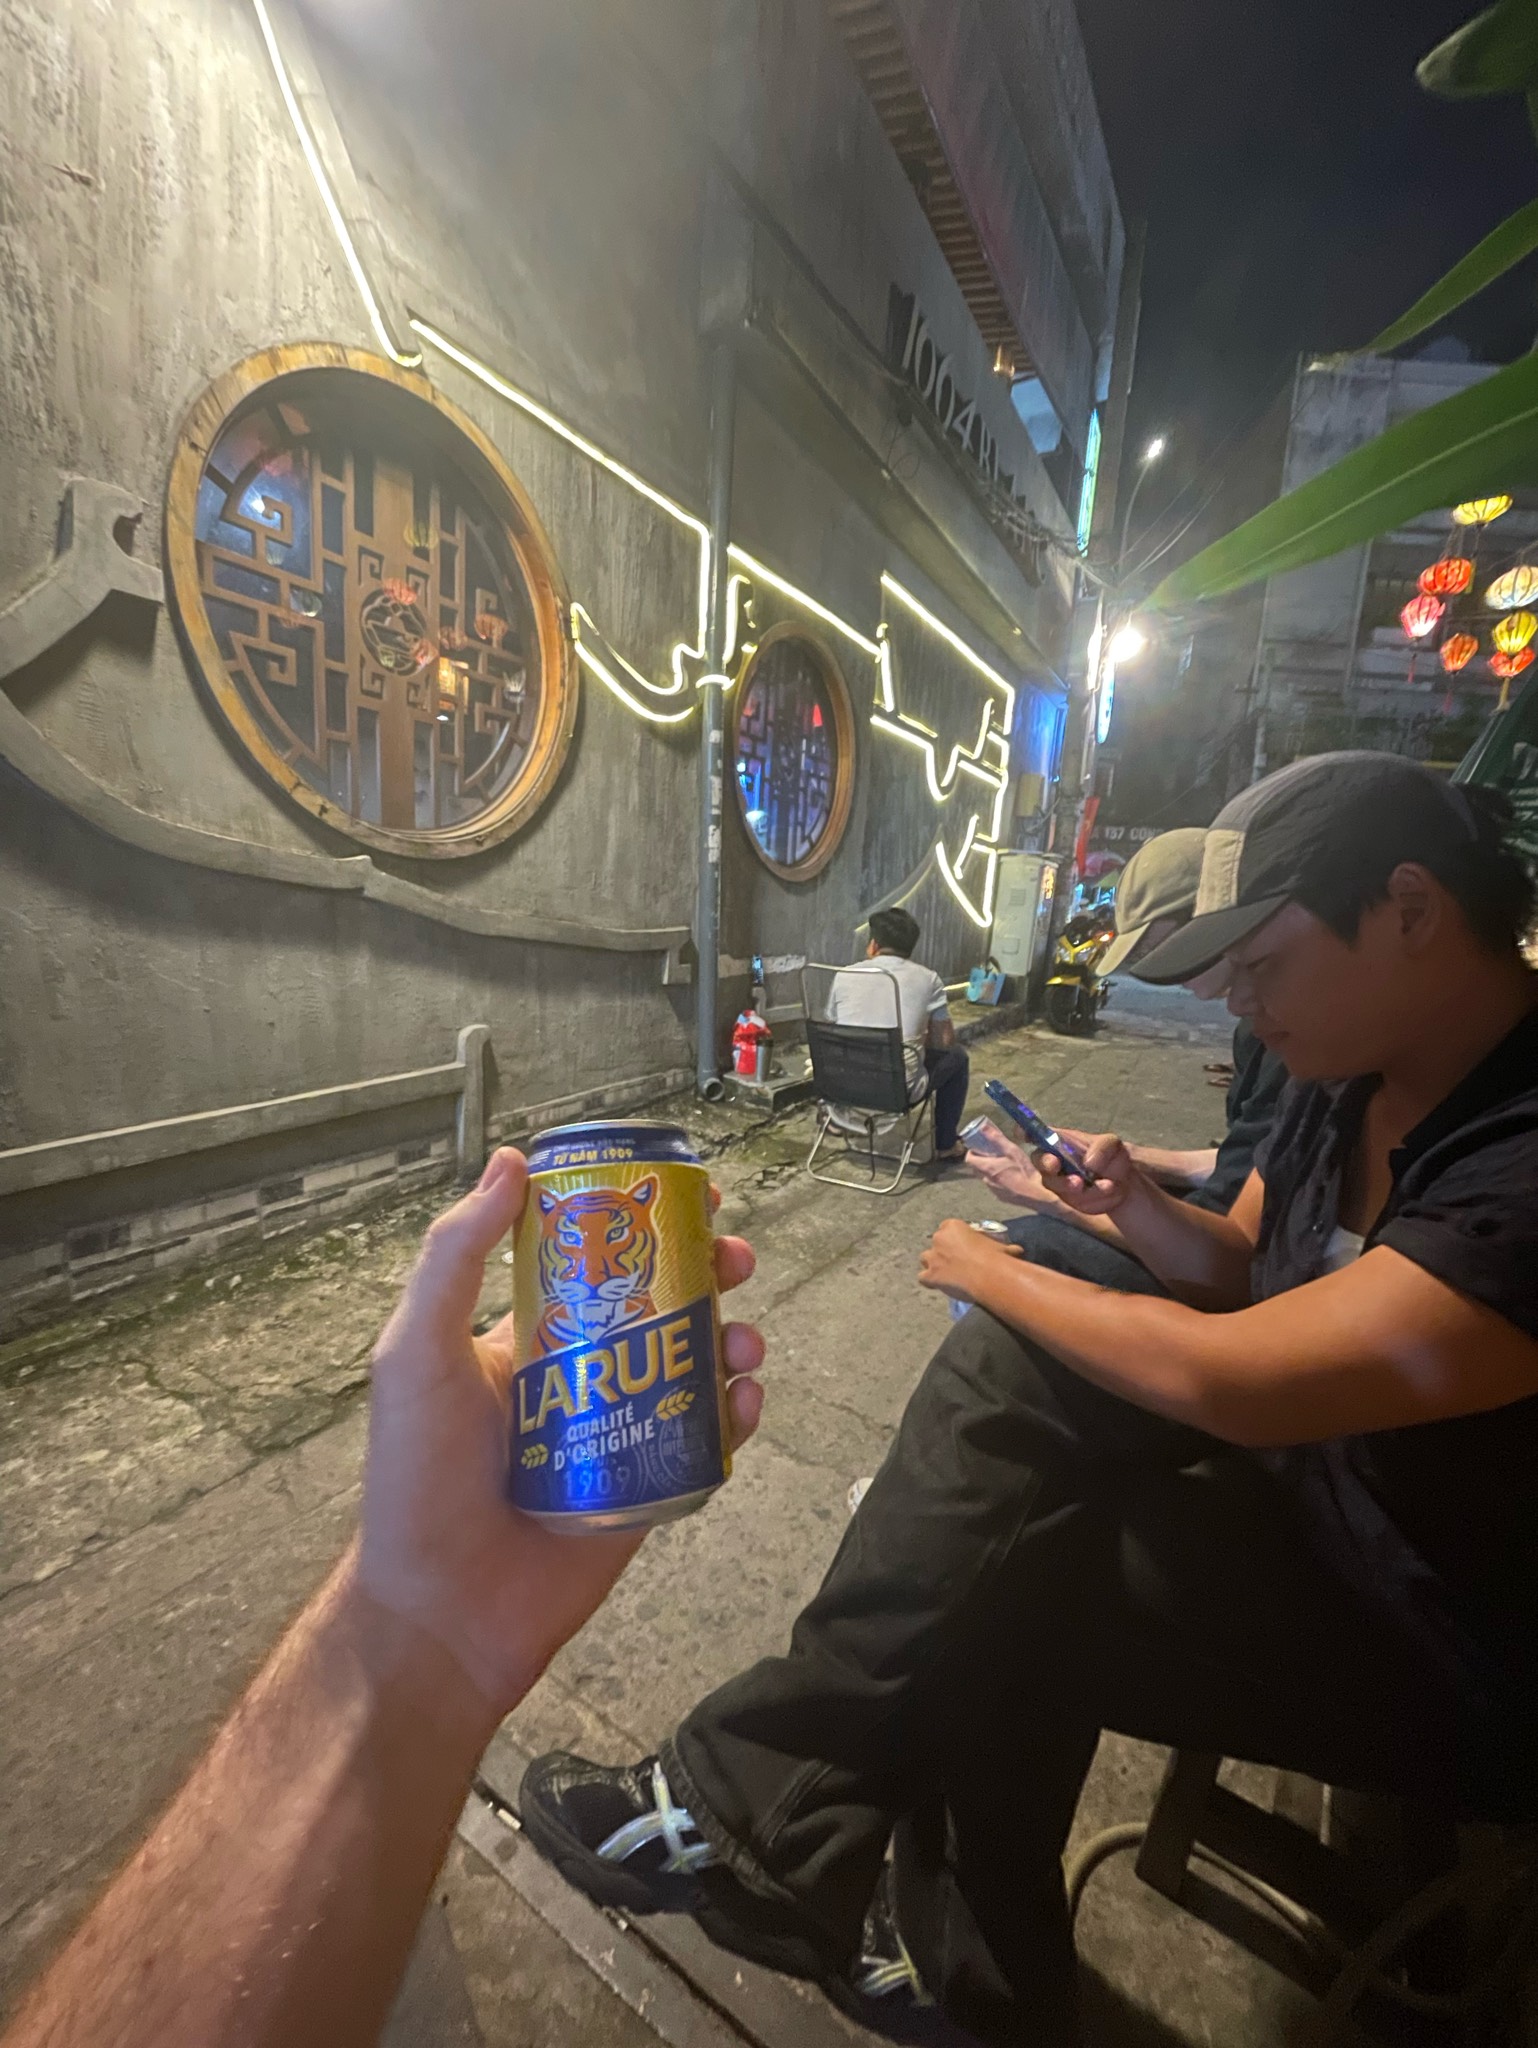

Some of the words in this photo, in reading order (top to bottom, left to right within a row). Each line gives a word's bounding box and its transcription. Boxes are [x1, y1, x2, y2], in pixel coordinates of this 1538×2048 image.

[602, 1147, 633, 1160] 1909
[517, 1315, 694, 1435] LARUE
[566, 1402, 635, 1443] QUALITÉ
[554, 1419, 655, 1471] D'ORIGINE
[563, 1466, 631, 1498] 1909
